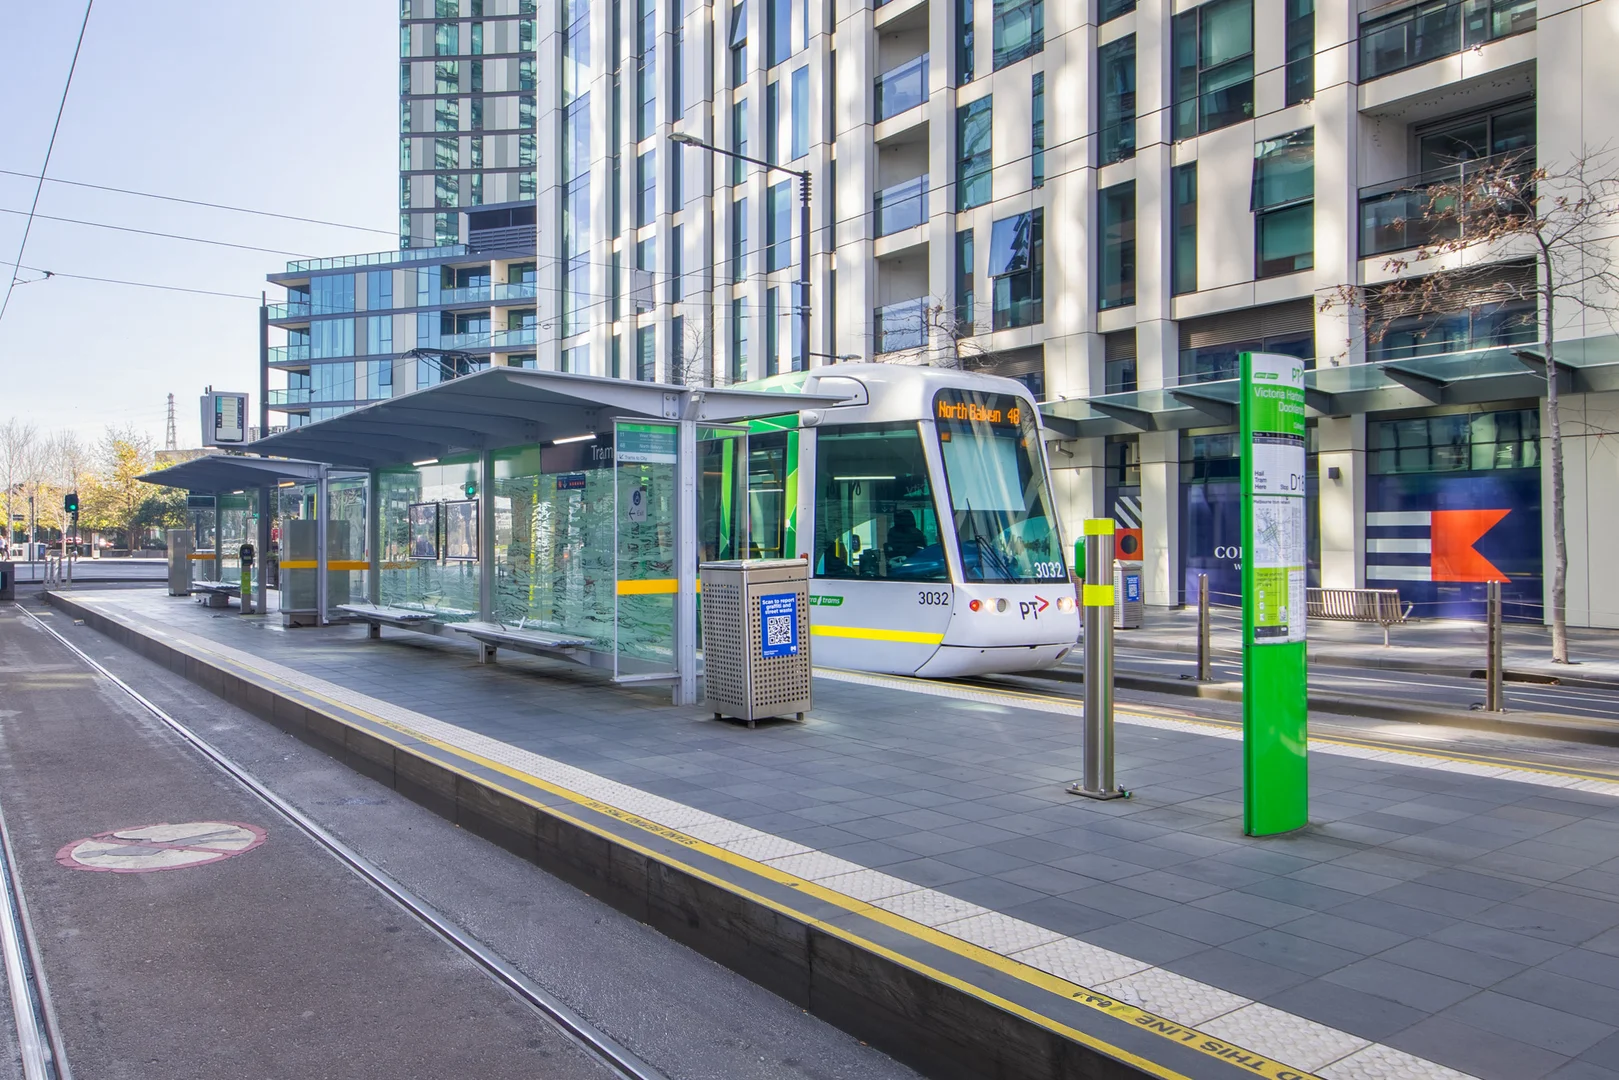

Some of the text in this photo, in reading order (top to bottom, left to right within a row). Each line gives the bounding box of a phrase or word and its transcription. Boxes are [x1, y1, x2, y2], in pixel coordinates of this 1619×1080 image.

[1254, 386, 1285, 400] Victoria
[938, 400, 1021, 425] North Balwyn 48
[590, 444, 614, 461] Tram
[1034, 562, 1064, 578] 3032
[918, 591, 949, 606] 3032
[1134, 1014, 1197, 1042] LINE
[1199, 1040, 1266, 1070] THIS
